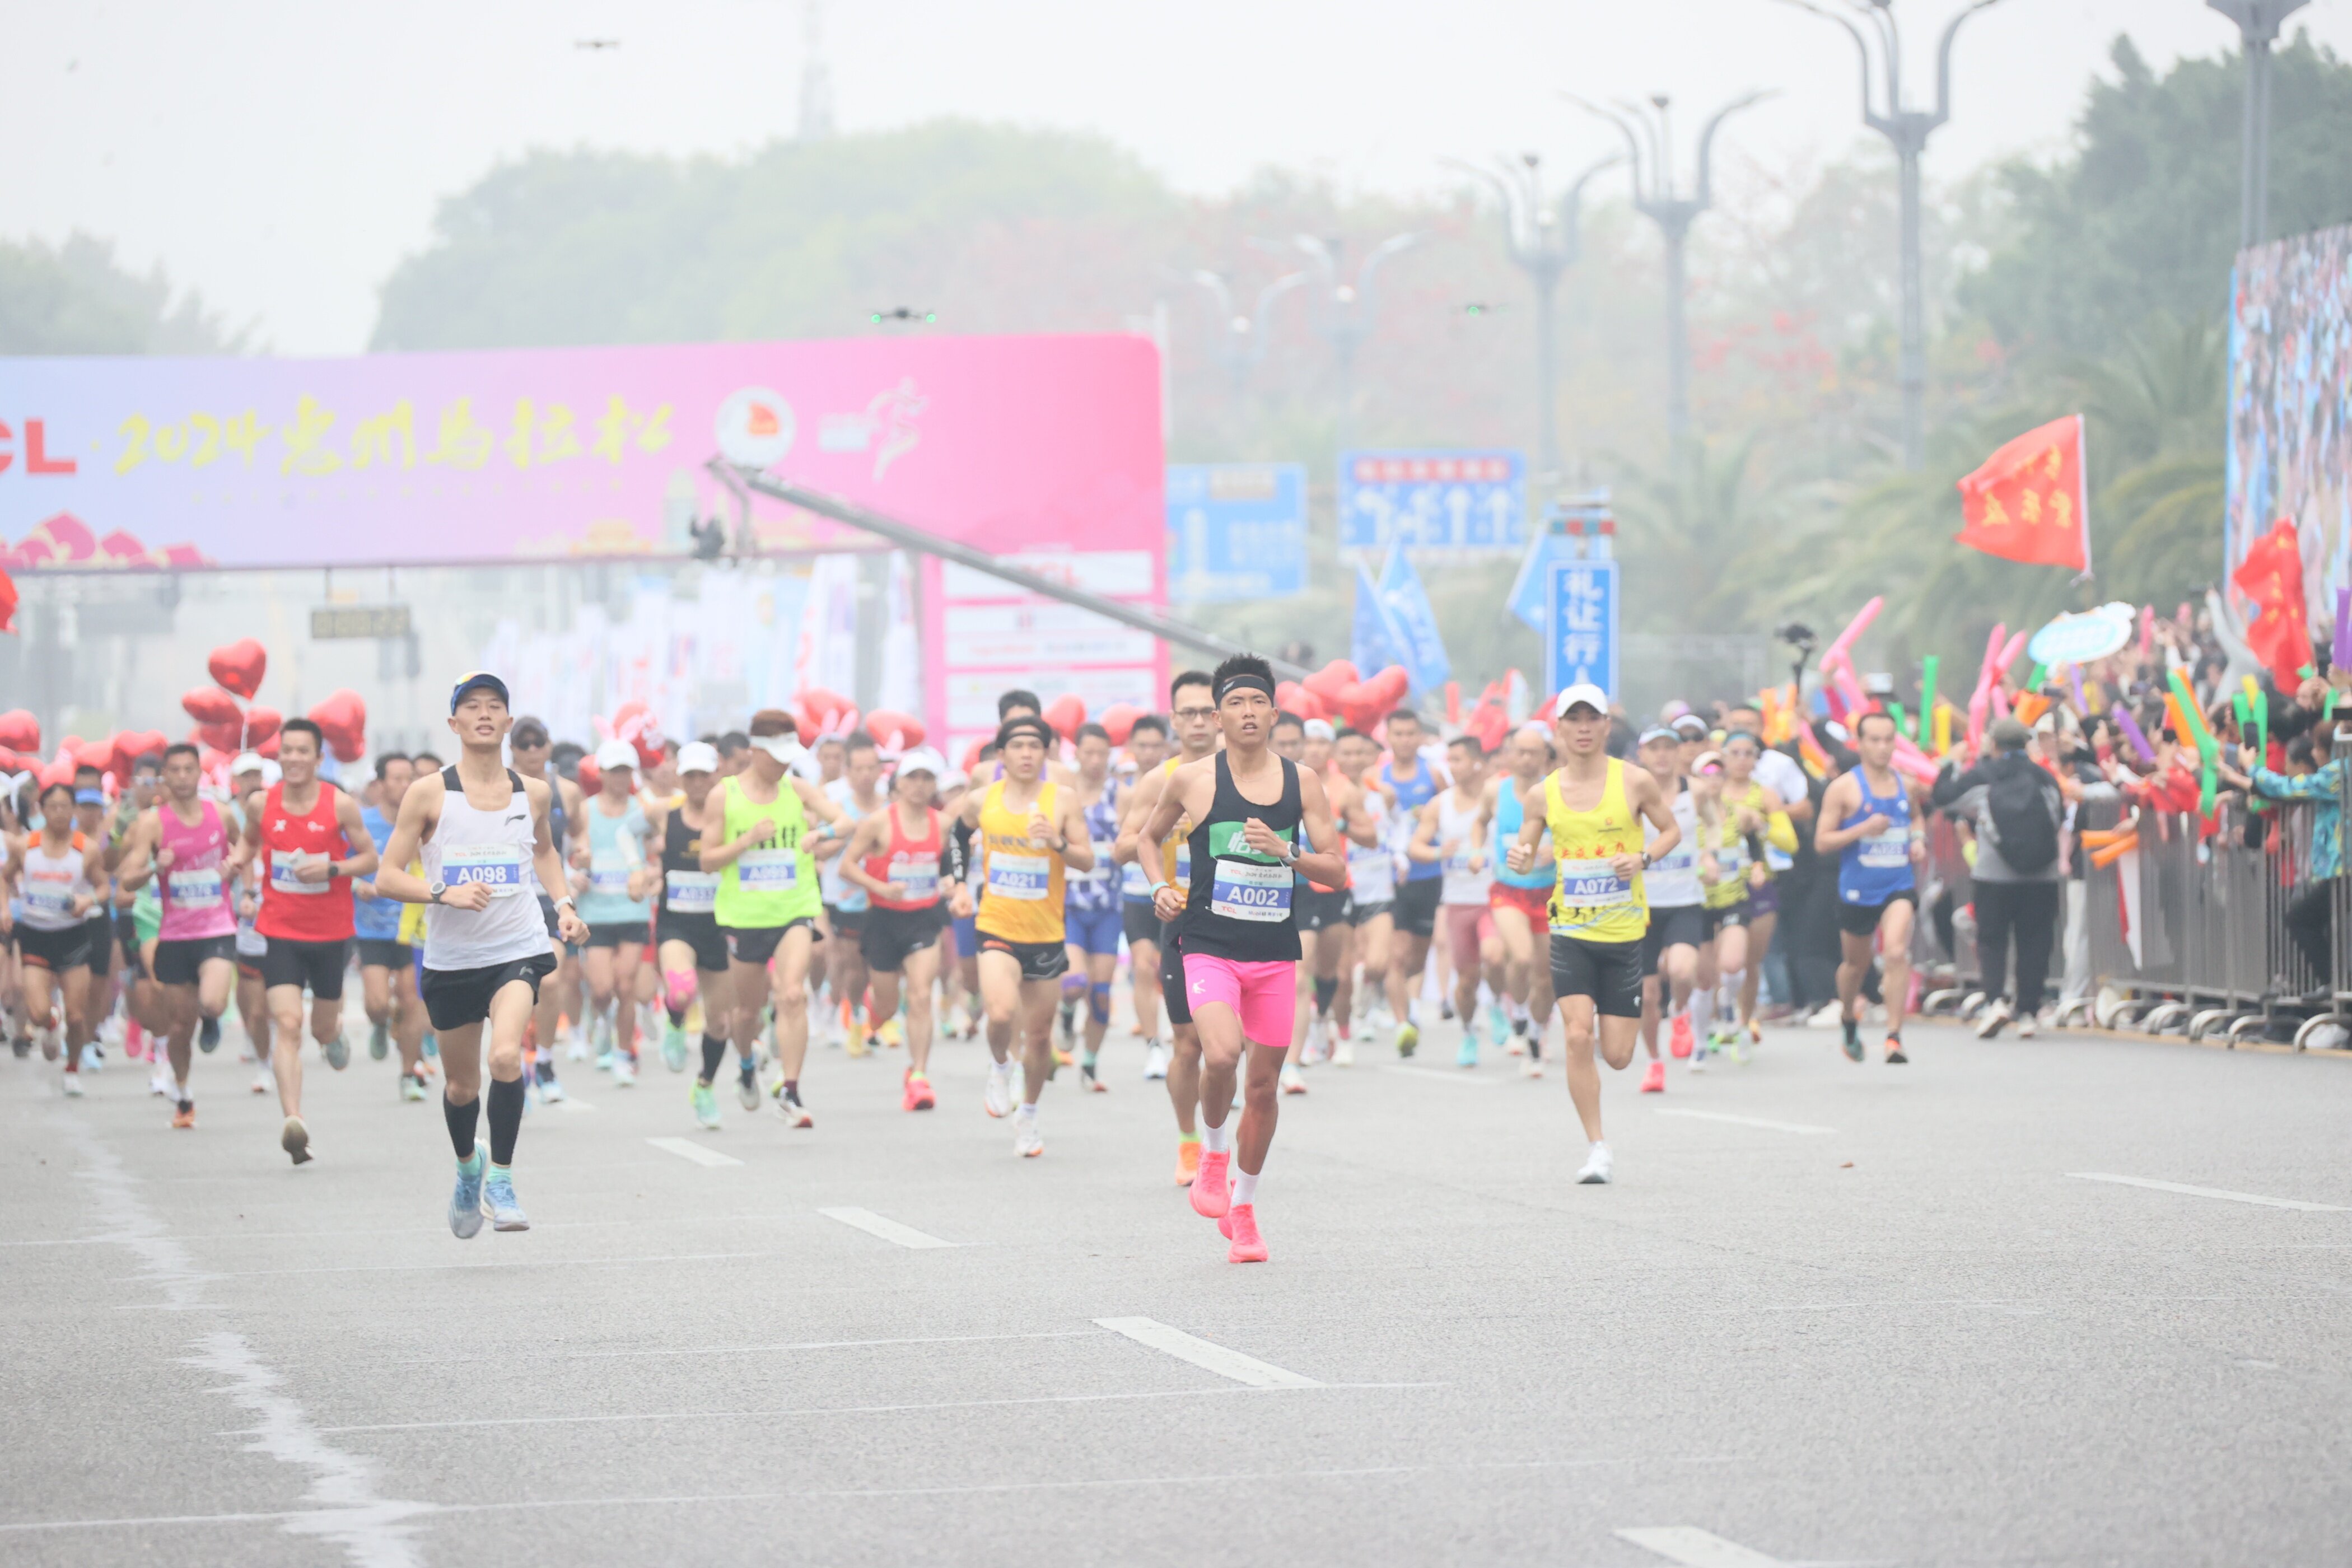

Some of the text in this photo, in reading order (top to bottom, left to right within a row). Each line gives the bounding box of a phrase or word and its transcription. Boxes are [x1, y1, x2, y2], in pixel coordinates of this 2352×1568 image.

[0, 418, 77, 475] L
[1228, 830, 1279, 855] 怡
[456, 866, 507, 884] A098
[997, 871, 1036, 888] A021
[1574, 878, 1618, 894] A072
[1227, 885, 1279, 906] A002
[1221, 906, 1236, 914] TCL
